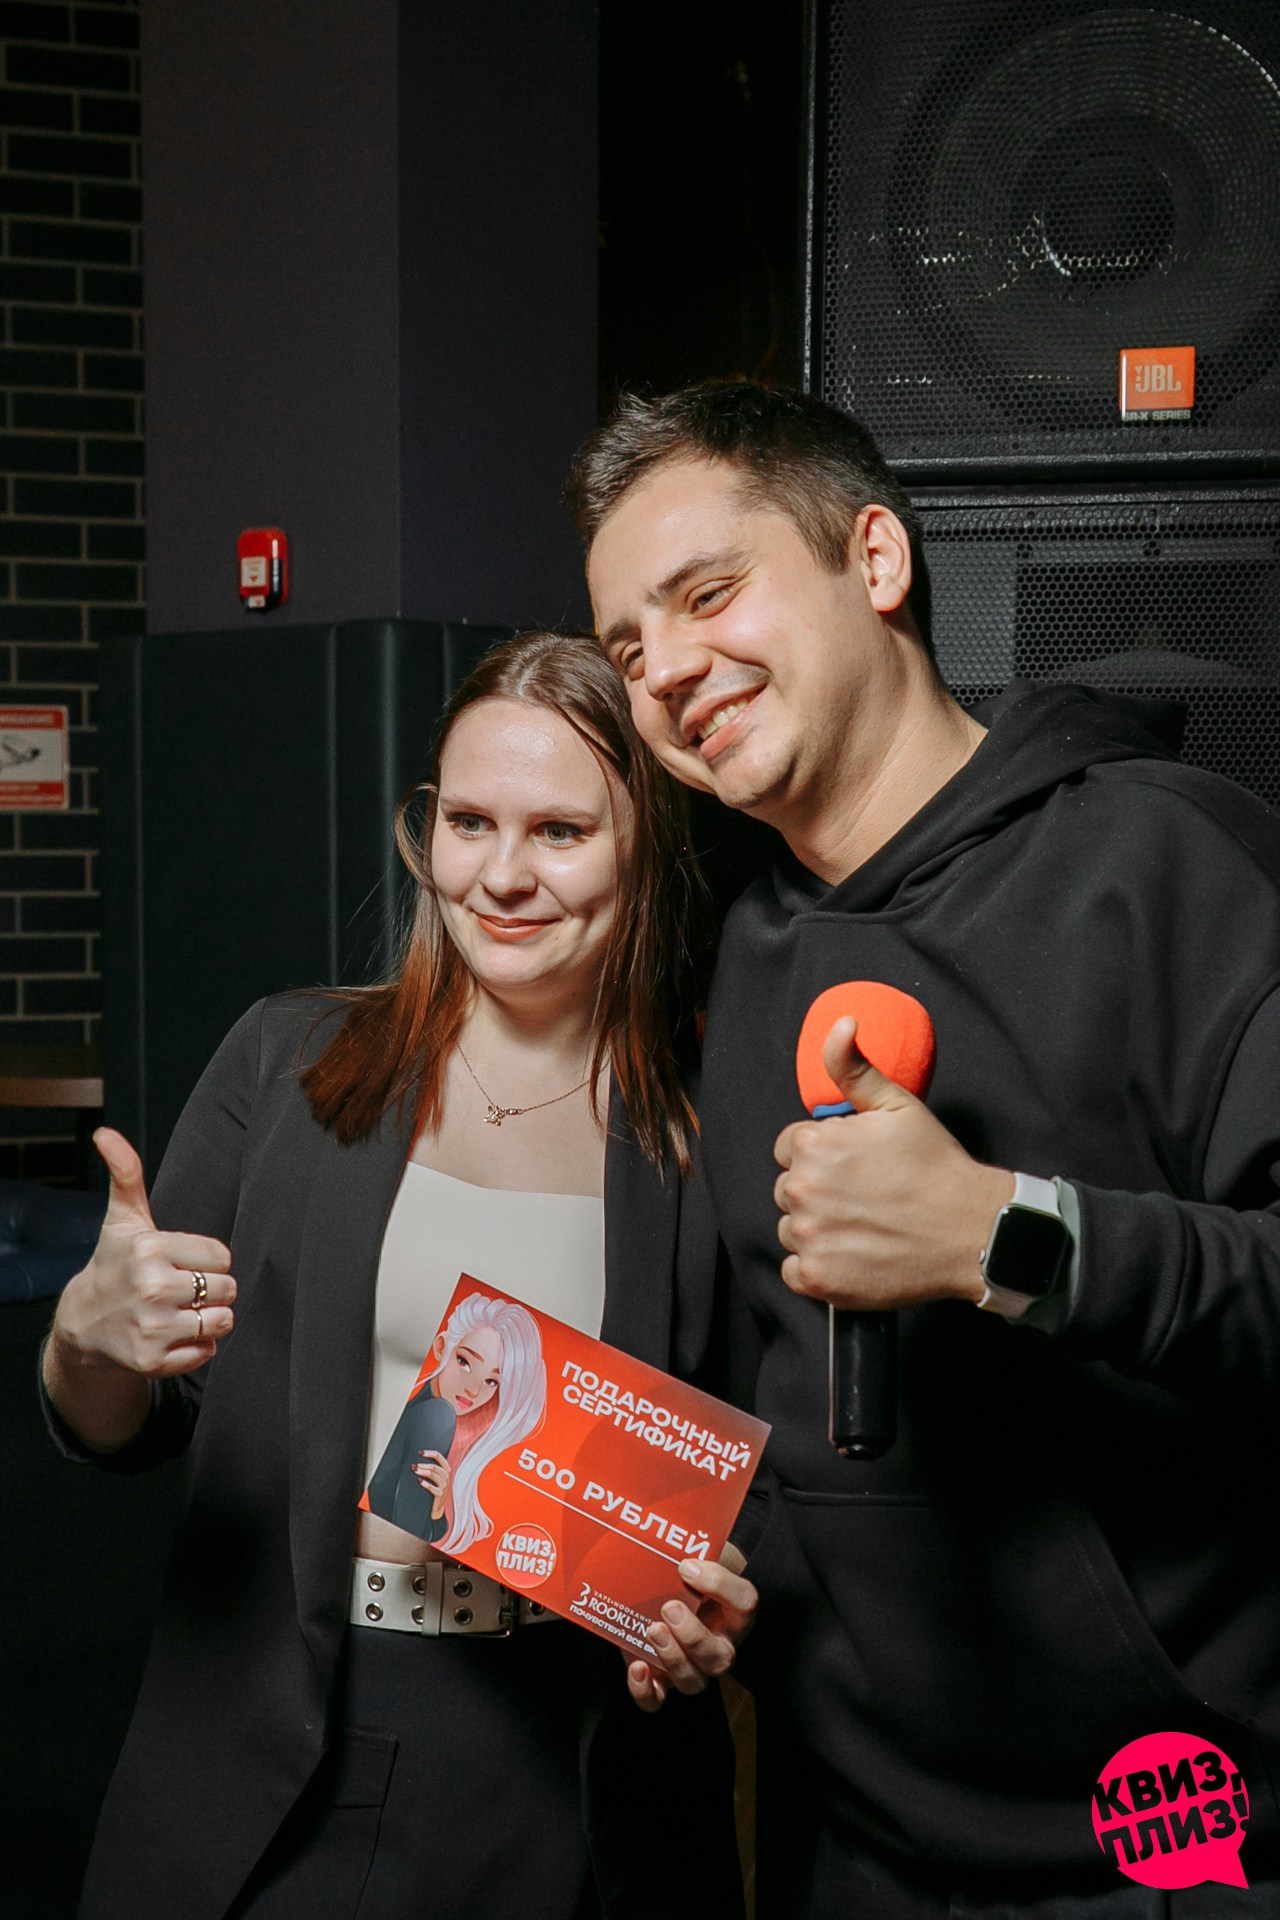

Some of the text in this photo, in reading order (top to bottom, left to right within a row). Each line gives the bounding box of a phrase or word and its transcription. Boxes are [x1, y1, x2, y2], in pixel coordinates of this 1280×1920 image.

[1135, 364, 1182, 393] JBL
[1152, 409, 1191, 421] SERIES
[561, 1360, 751, 1469] ПОДАРОЧНЫЙ
[562, 1384, 736, 1482] СЕРТИФИКАТ
[517, 1448, 711, 1561] 500 РУБЛЕЙ
[496, 1550, 554, 1578] ПЛИЗ!
[569, 1603, 626, 1639] ПОЧУВСТВУЙ
[625, 1633, 645, 1649] ВСЕ
